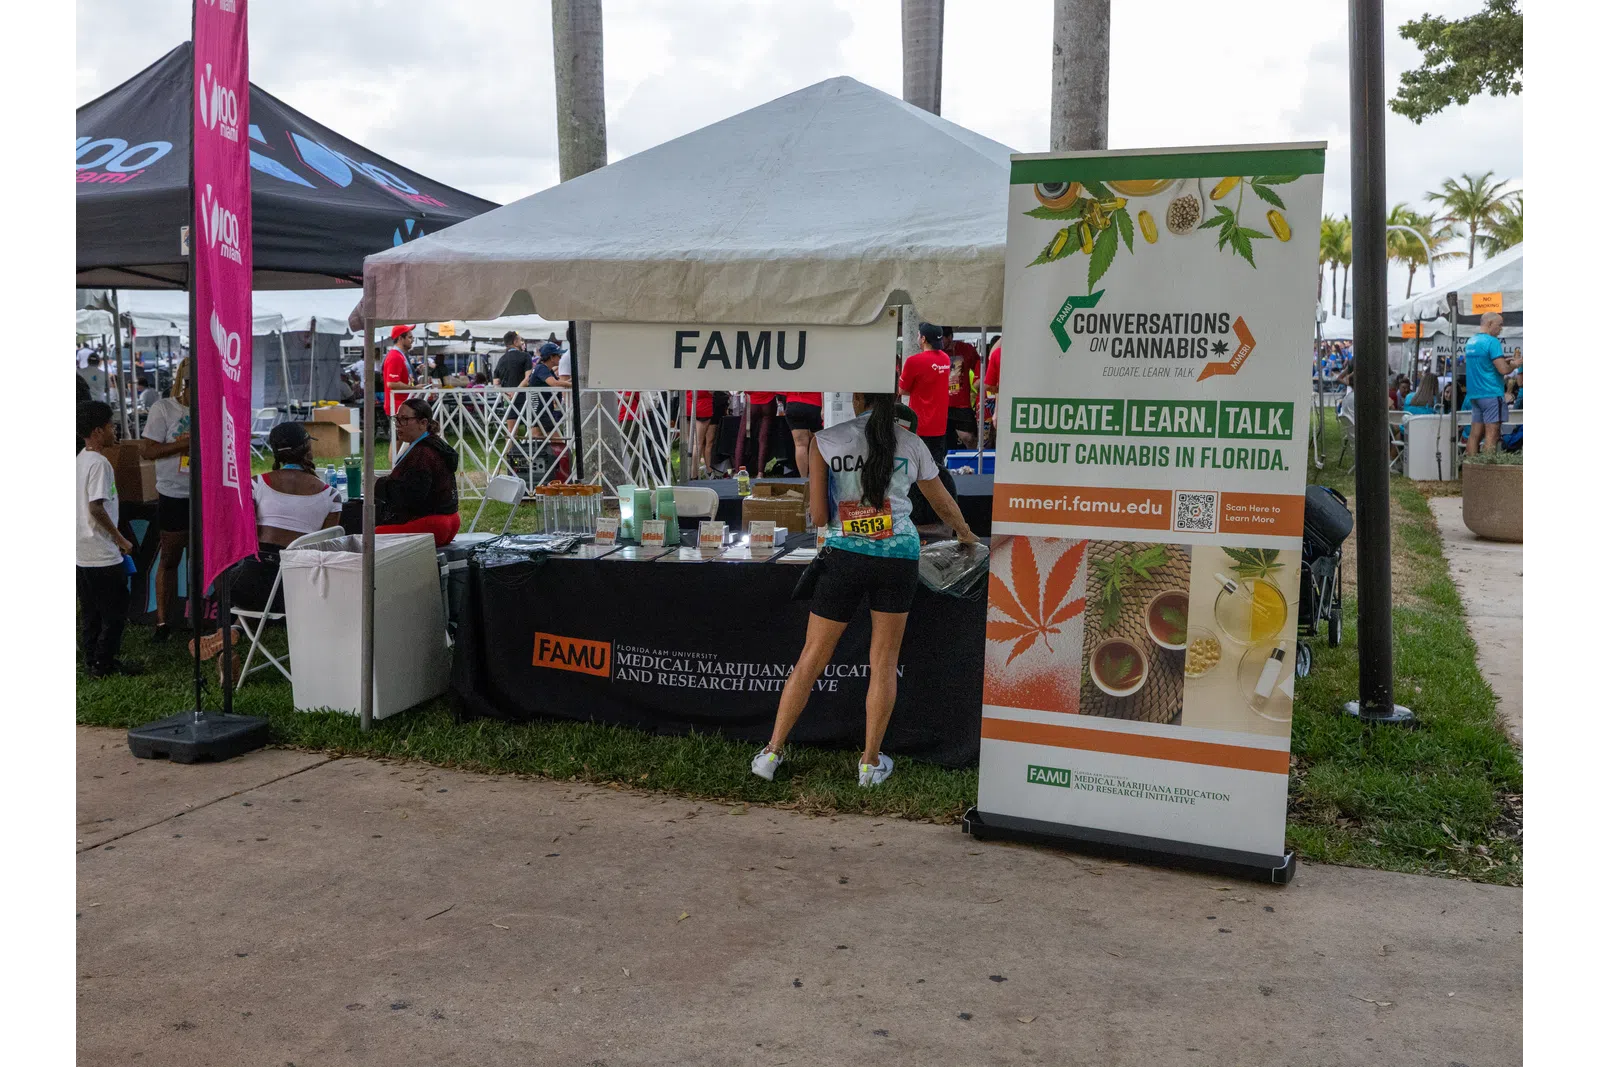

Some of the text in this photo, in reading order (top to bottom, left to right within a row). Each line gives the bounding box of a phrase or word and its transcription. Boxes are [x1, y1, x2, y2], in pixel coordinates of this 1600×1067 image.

[1056, 301, 1073, 324] FAMU
[1073, 313, 1230, 335] CONVERSATIONS
[673, 330, 807, 371] FAMU
[1089, 337, 1209, 359] ON CANNABIS
[1230, 344, 1252, 370] MMERI
[1102, 366, 1195, 378] EDUCATE. LEARN. TALK.
[1015, 403, 1291, 436] EDUCATE. LEARN. TALK.
[1010, 441, 1290, 471] ABOUT CANNABIS IN FLORIDA.
[1008, 495, 1163, 516] mmeri.famu.edu
[1225, 503, 1281, 514] Scan Here to
[850, 518, 885, 534] 6513
[1225, 514, 1275, 525] Learn More
[538, 638, 606, 670] FAMU
[616, 644, 718, 660] FLORIDA A&M UNIVERSITY
[616, 651, 905, 678] MEDICAL MARIJUANA UCATN
[616, 667, 653, 683] AND
[657, 672, 745, 692] RESEARCH
[1029, 767, 1068, 785] FAMU
[1073, 783, 1196, 805] AND RESEARCH INITIATIVE
[1074, 775, 1231, 802] MEDICAL MARIJUANA EDUCATION
